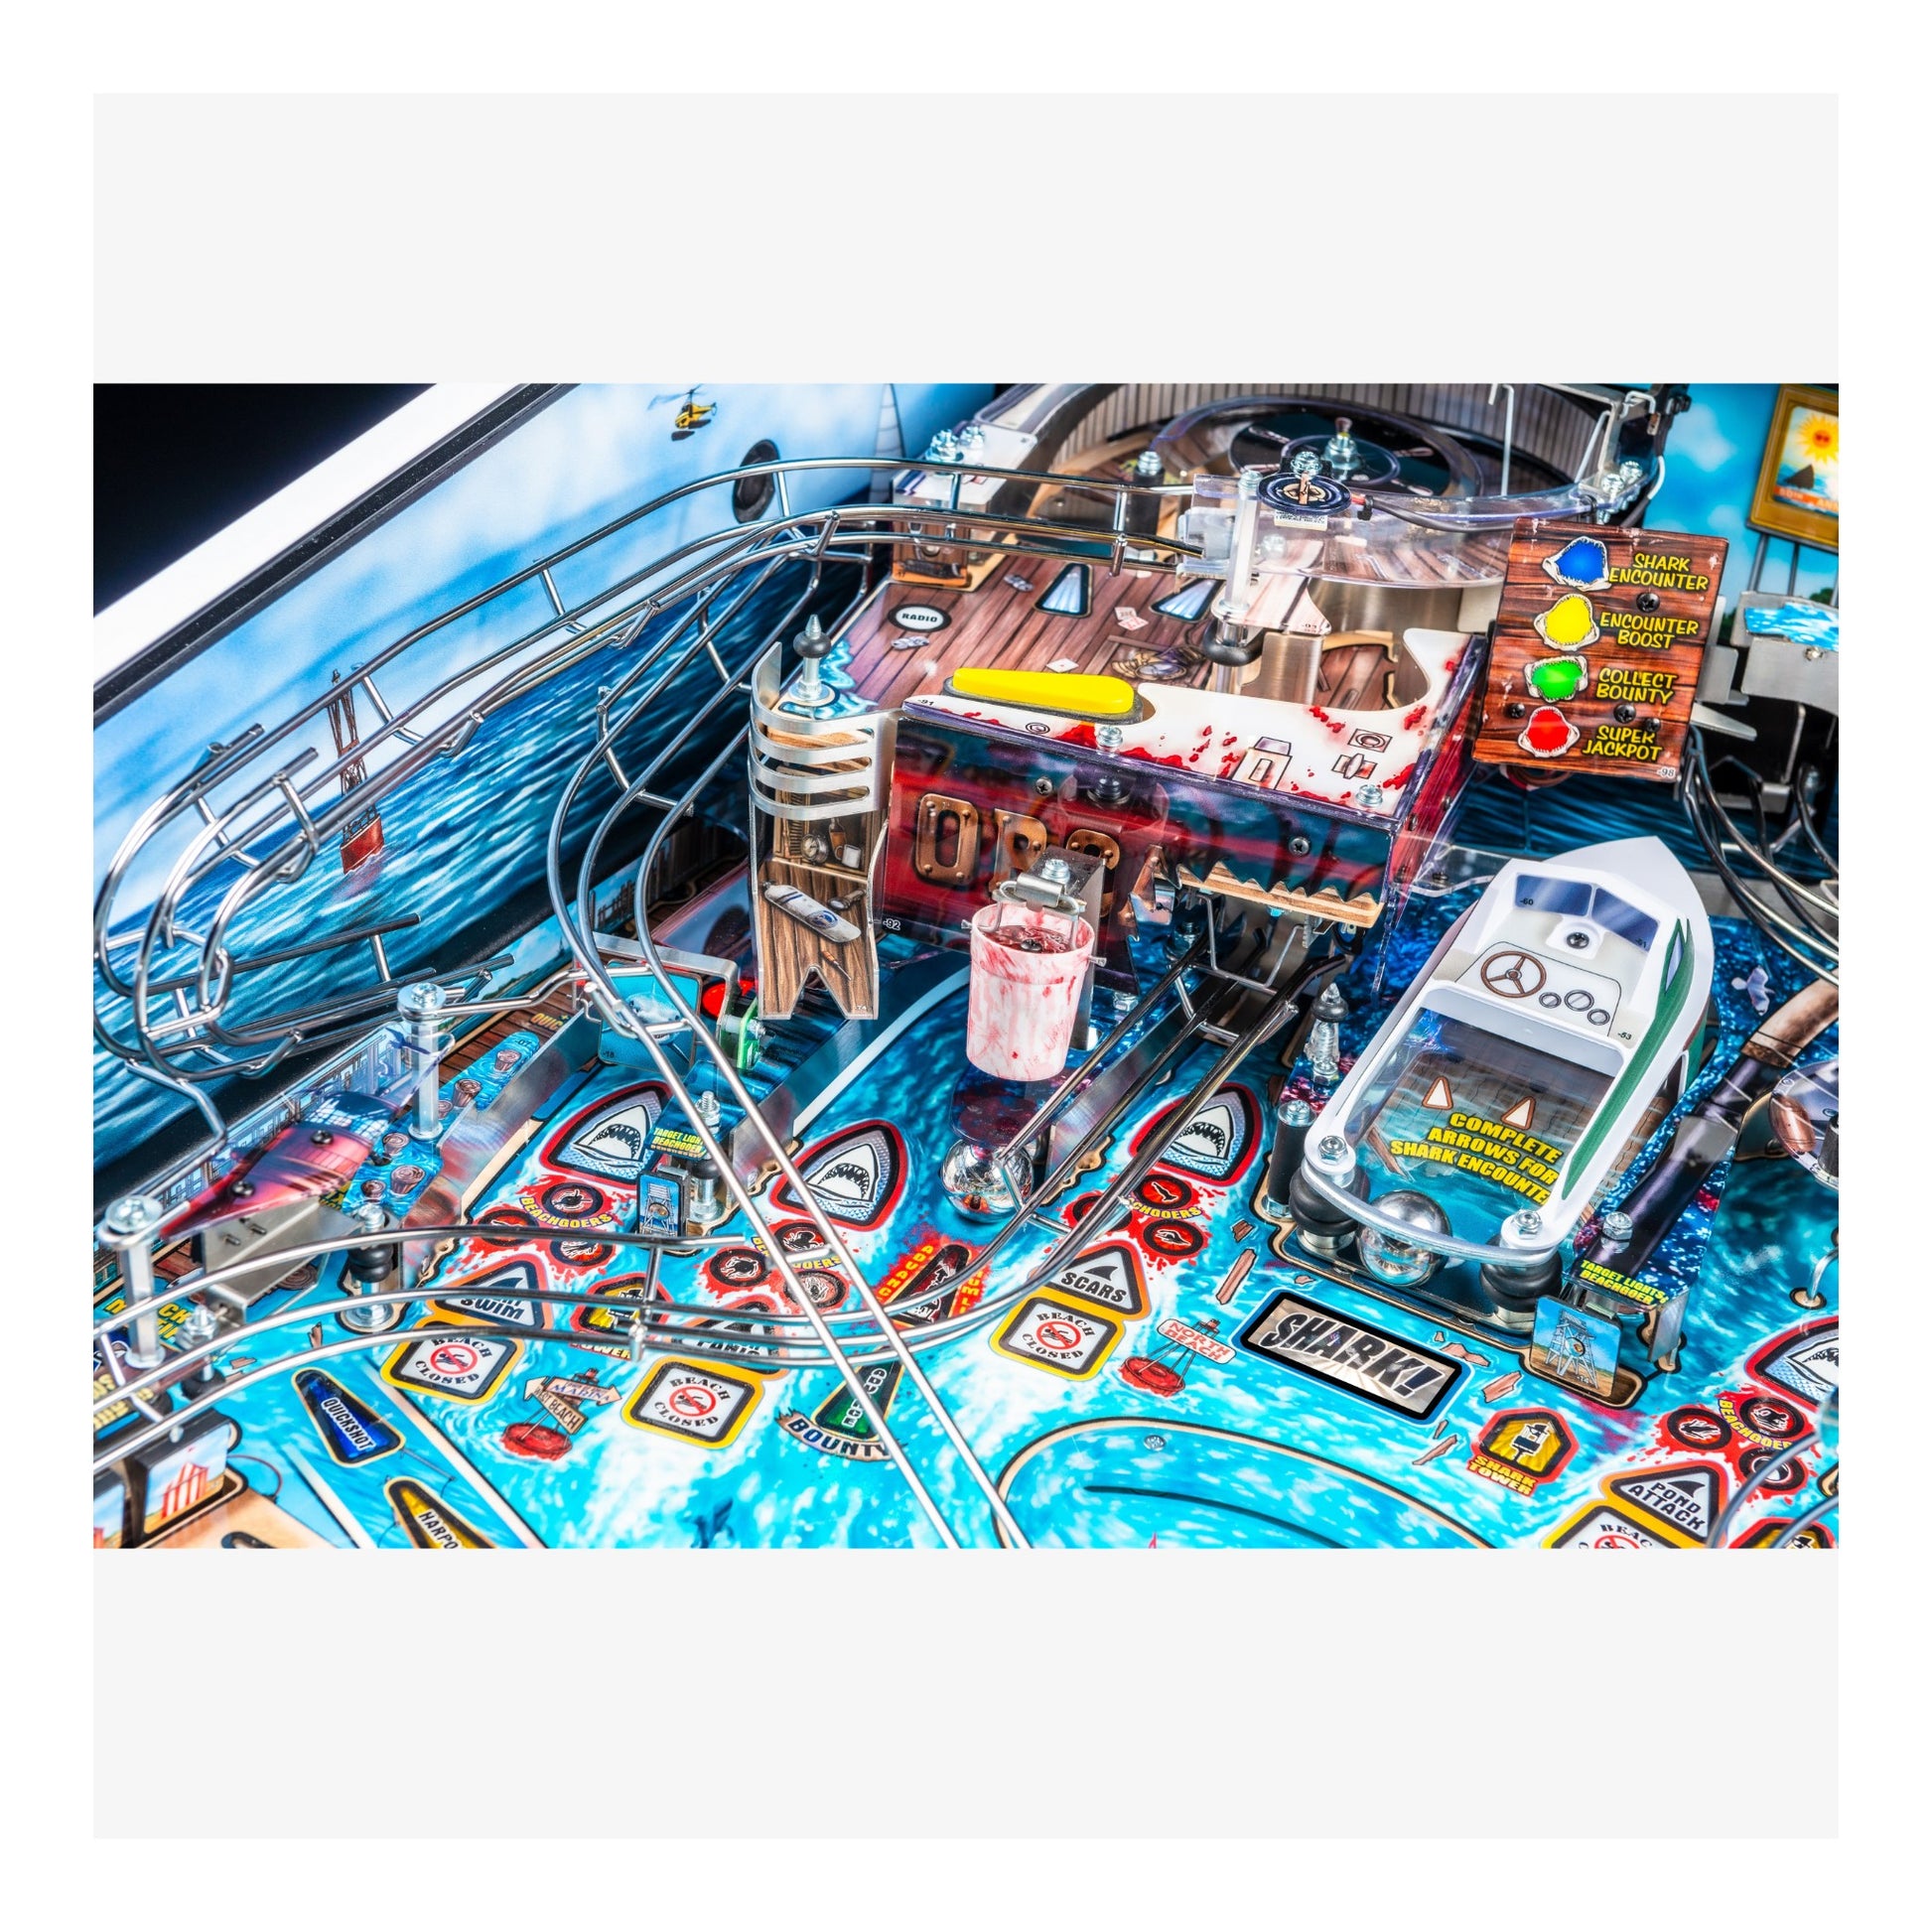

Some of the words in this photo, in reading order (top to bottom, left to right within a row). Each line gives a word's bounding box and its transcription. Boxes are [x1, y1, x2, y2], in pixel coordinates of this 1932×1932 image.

[1632, 553, 1691, 573] SHARK
[1608, 568, 1709, 591] ENCOUNTER
[901, 613, 938, 622] RADIO
[1599, 612, 1700, 635] ENCOUNTER
[1617, 629, 1675, 649] BOOST
[1598, 667, 1678, 690] COLLECT
[1596, 684, 1675, 705] BOUNTY
[1596, 725, 1656, 745] SUPER
[1583, 740, 1663, 761] JACKPOT
[1657, 766, 1676, 777] -98
[882, 919, 901, 931] -92
[530, 1013, 564, 1032] QUIC
[651, 1136, 703, 1153] BEACHGOER
[653, 1127, 683, 1141] TARGET
[682, 1134, 704, 1145] LIGH
[1449, 1112, 1564, 1164] COMPLETE
[1427, 1127, 1521, 1166] ARROWS
[1517, 1157, 1560, 1185] FOR
[1390, 1140, 1458, 1165] SHARK
[1456, 1153, 1552, 1205] ENCOUNTE
[520, 1196, 613, 1228] BEACHGOERS
[876, 1245, 934, 1299] ADVANC
[1581, 1259, 1624, 1282] TARGET
[1623, 1277, 1667, 1300] LIGHTS
[1060, 1272, 1127, 1303] SCARS
[1580, 1269, 1655, 1305] BEACHGOER
[460, 1298, 525, 1320] SWIM
[1036, 1311, 1095, 1336] BEACH
[1022, 1333, 1083, 1359] CLOSED
[1165, 1328, 1222, 1360] BEACH
[1169, 1321, 1230, 1355] NORTH
[1258, 1312, 1446, 1399] SHARK!
[415, 1360, 480, 1384] CLOSED
[551, 1384, 610, 1401] MARINA
[669, 1377, 731, 1400] BEACH
[322, 1397, 375, 1450] QUICKSHOT
[548, 1399, 581, 1430] BEACH
[653, 1401, 718, 1427] CLOSED
[1719, 1399, 1793, 1450] BEACHGOER
[1469, 1461, 1532, 1495] TOWER
[1474, 1455, 1536, 1487] SHARK
[1627, 1484, 1705, 1531] ATTACK
[1650, 1481, 1702, 1514] POND
[1600, 1524, 1653, 1549] BEAC
